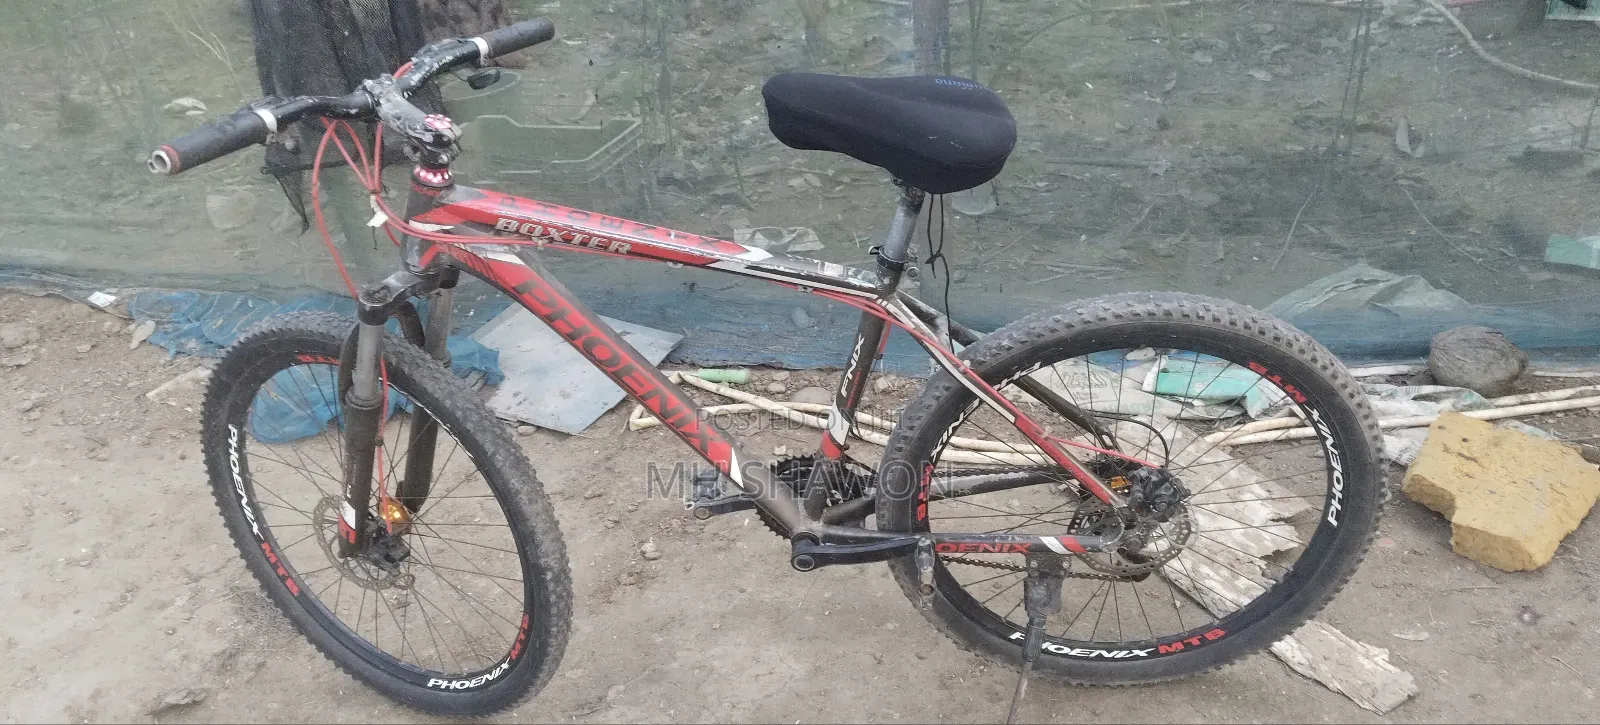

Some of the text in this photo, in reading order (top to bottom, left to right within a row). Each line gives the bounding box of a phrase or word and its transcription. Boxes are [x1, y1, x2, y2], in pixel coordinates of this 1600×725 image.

[494, 216, 633, 255] BOXTER
[513, 278, 721, 454] PHOENIX
[840, 332, 866, 398] FNIX
[1248, 361, 1344, 528] PHOENIX MTB
[227, 424, 301, 596] PHOENIX MTB
[935, 542, 1033, 554] OENIX
[427, 613, 530, 690] PHOENIX MTB
[1157, 628, 1228, 654] MTB
